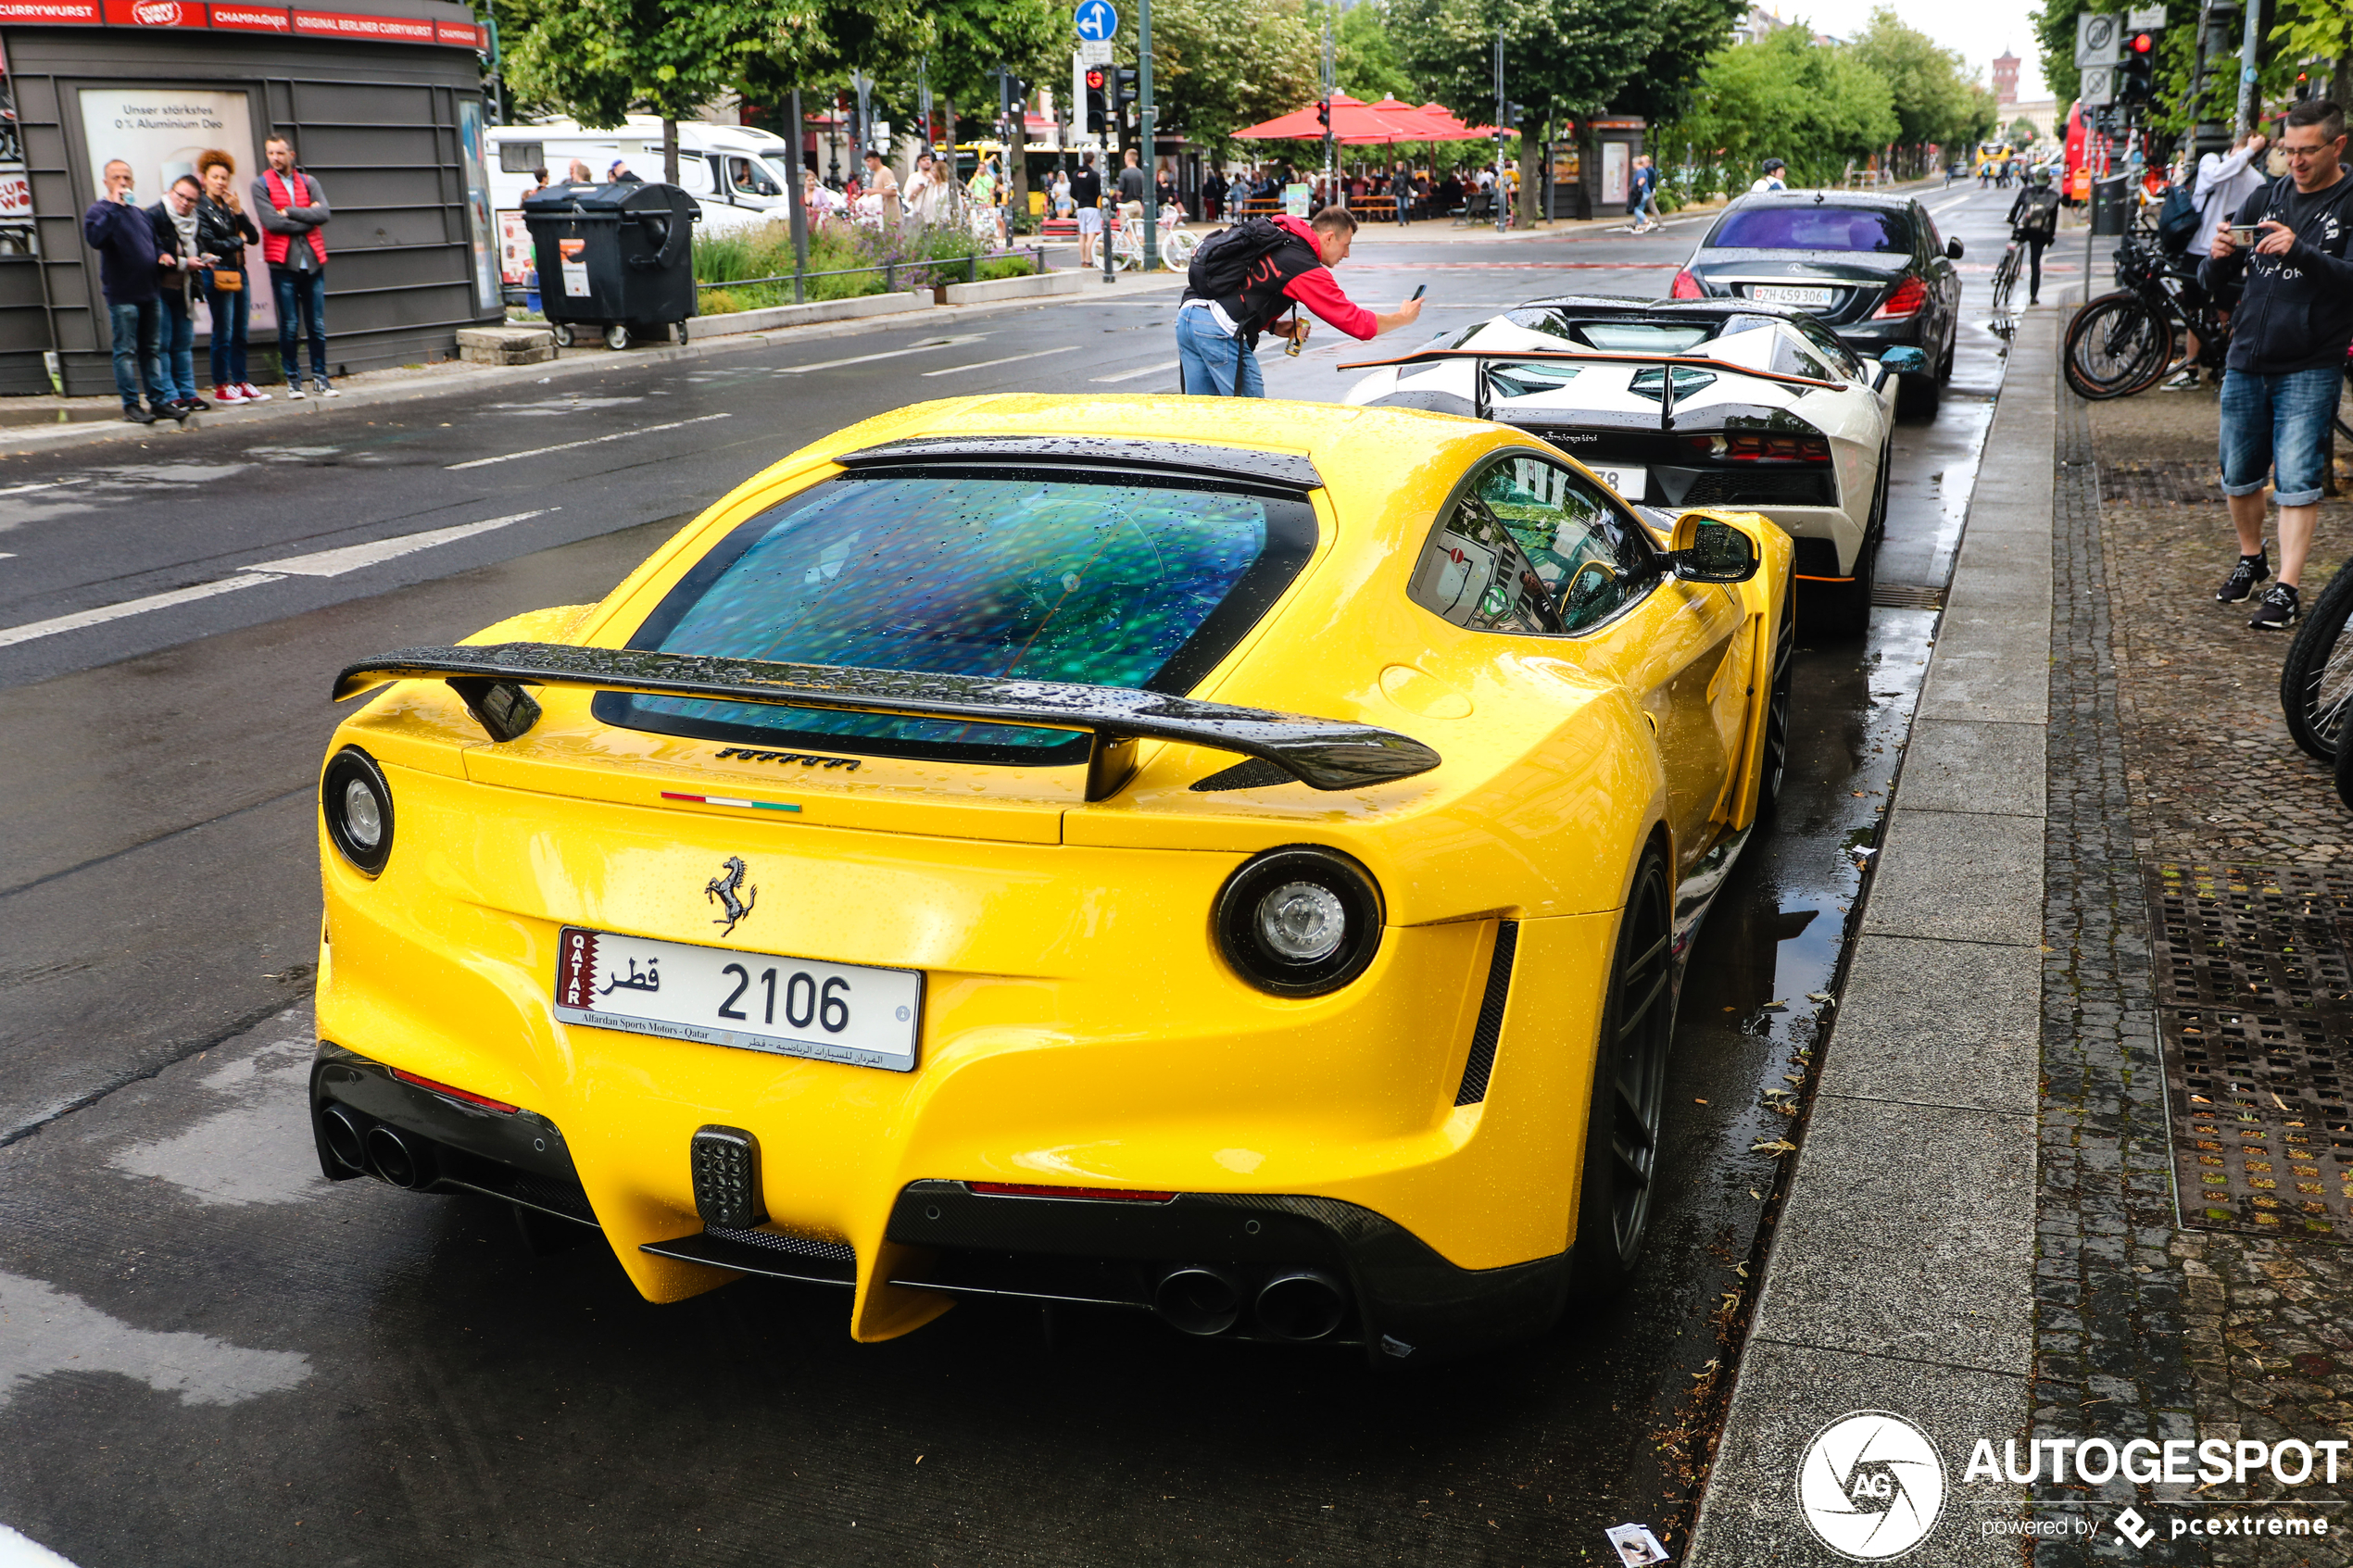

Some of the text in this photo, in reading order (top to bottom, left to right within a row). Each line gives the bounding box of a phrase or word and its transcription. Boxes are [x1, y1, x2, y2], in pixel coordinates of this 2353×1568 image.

[0, 5, 93, 17] CURRYWURST
[215, 11, 288, 29] CHAMPAGNER
[296, 16, 432, 37] ORIGINAL BERLINER CURRYWURST
[122, 105, 157, 115] Unser
[137, 119, 199, 129] Aluminium
[202, 119, 223, 129] Deo
[568, 935, 585, 1005] QATAR
[596, 956, 660, 996] قطر
[718, 962, 850, 1033] 2106
[582, 1013, 618, 1027] Alfardan
[620, 1018, 647, 1030] Sports
[648, 1022, 678, 1035] Motors
[685, 1027, 710, 1039] Qatar
[748, 1037, 766, 1048] قطر
[775, 1041, 812, 1056] الرياضية
[814, 1047, 852, 1060] للسيارات
[854, 1054, 883, 1065] الفردان
